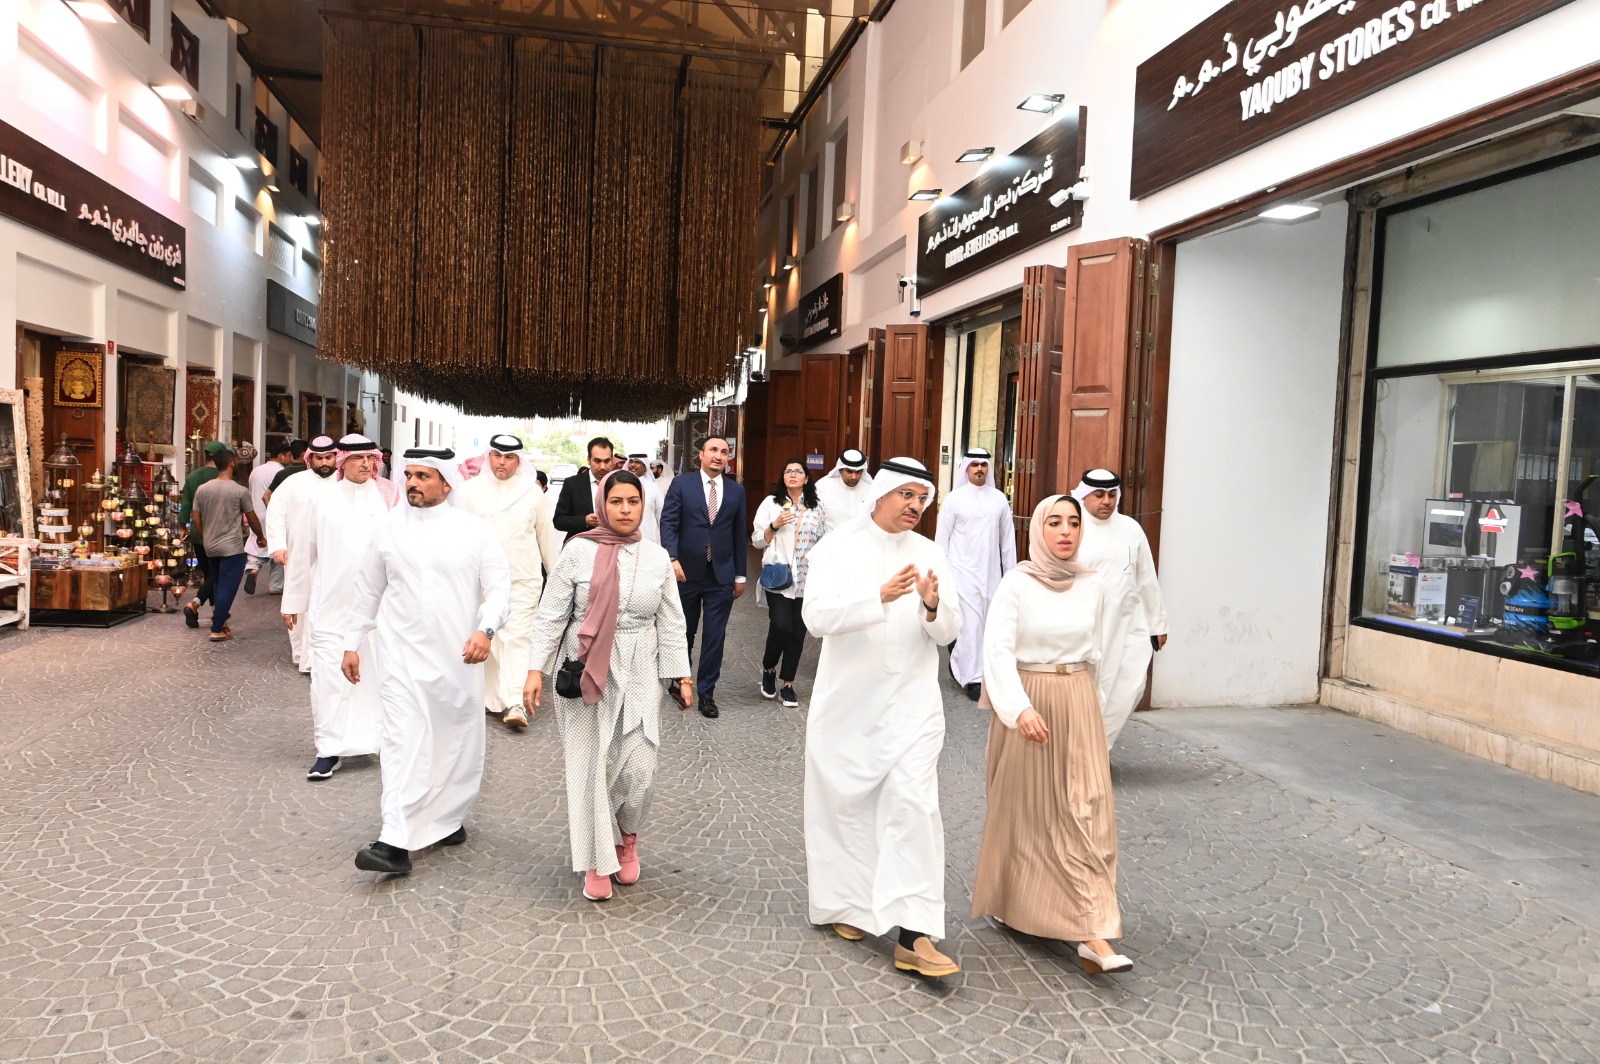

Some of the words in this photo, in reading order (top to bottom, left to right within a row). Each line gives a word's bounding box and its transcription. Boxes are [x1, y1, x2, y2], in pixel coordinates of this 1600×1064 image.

[1240, 52, 1316, 121] YAQUBY
[1318, 0, 1415, 81] STORES
[0, 154, 33, 194] LERY
[1011, 154, 1054, 204] شركة
[947, 194, 992, 239] للمجوهرات
[990, 187, 1011, 219] بحر
[111, 218, 148, 254] جاليري
[963, 226, 1000, 259] JEWELLERS
